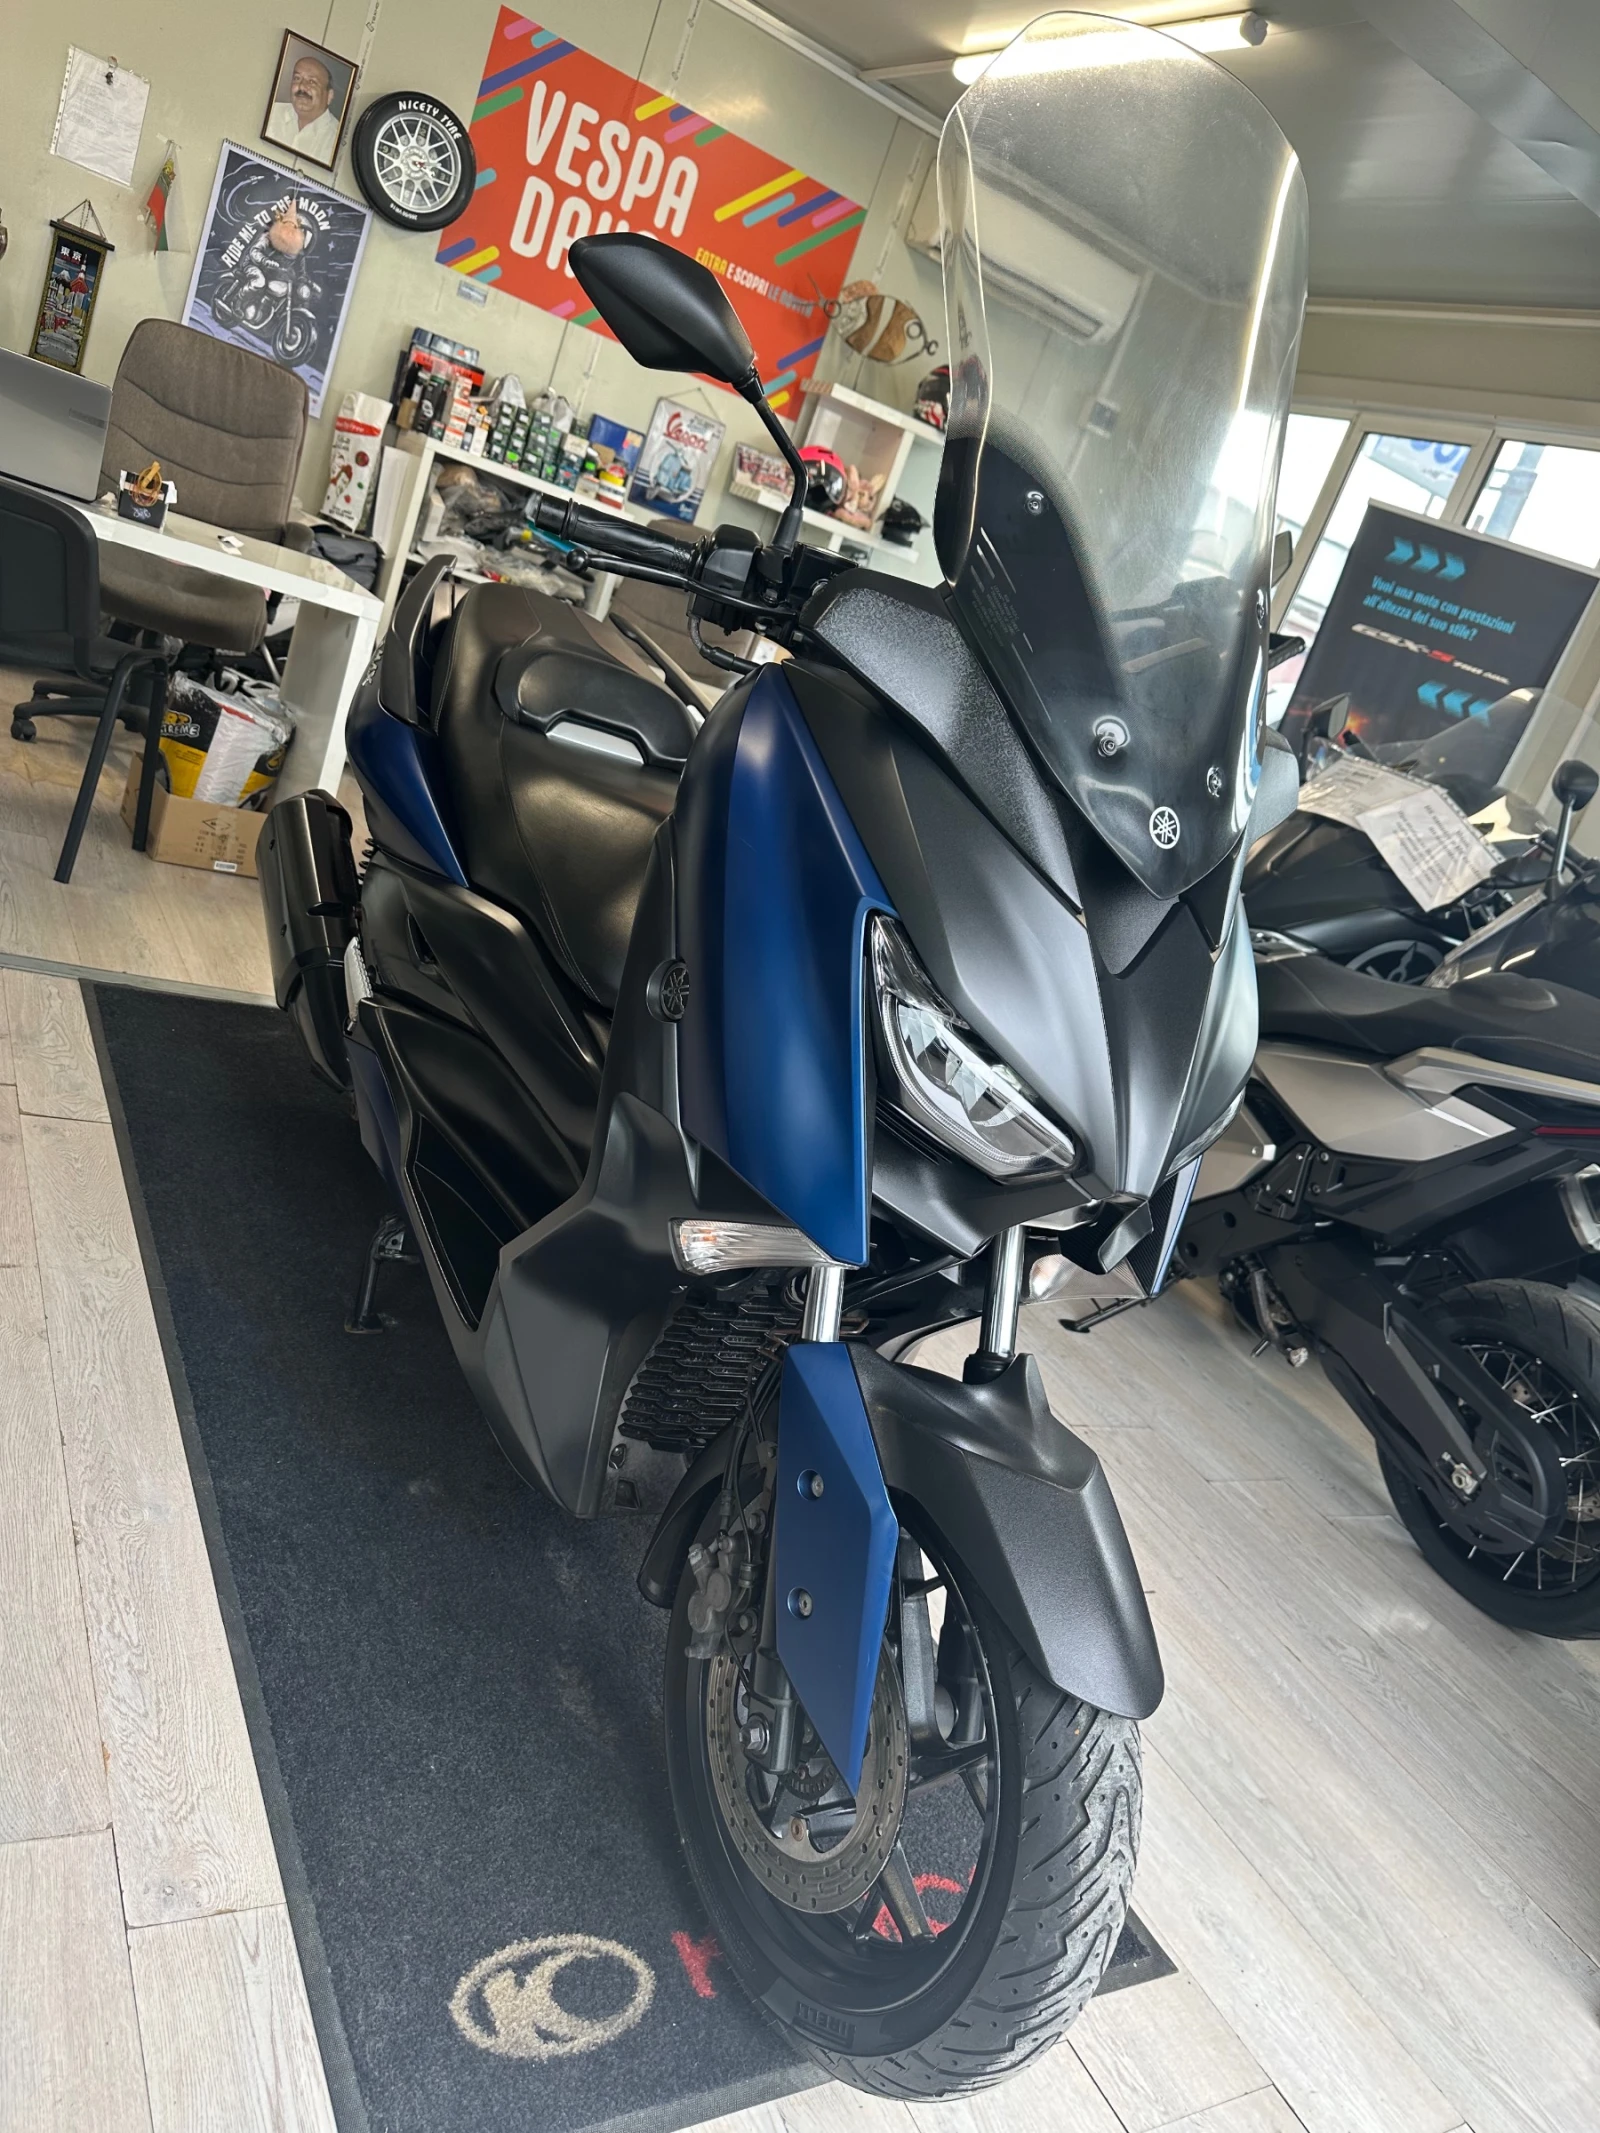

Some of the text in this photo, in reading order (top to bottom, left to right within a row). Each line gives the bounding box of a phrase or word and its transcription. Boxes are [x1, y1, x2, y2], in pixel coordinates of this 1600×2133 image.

[398, 99, 463, 140] NICETY TYRE
[526, 80, 699, 238] VESPA
[60, 246, 82, 262] 東京
[221, 195, 331, 268] RIDE ME TO THE MOON
[695, 247, 728, 276] ENTRA
[726, 262, 736, 280] E
[733, 266, 770, 297] SCOPRI
[767, 283, 781, 303] LE
[663, 411, 709, 454] Vespa
[1363, 594, 1479, 642] all'altezza del suo stile?
[1372, 575, 1516, 634] Vuoi una moto con prestazioni
